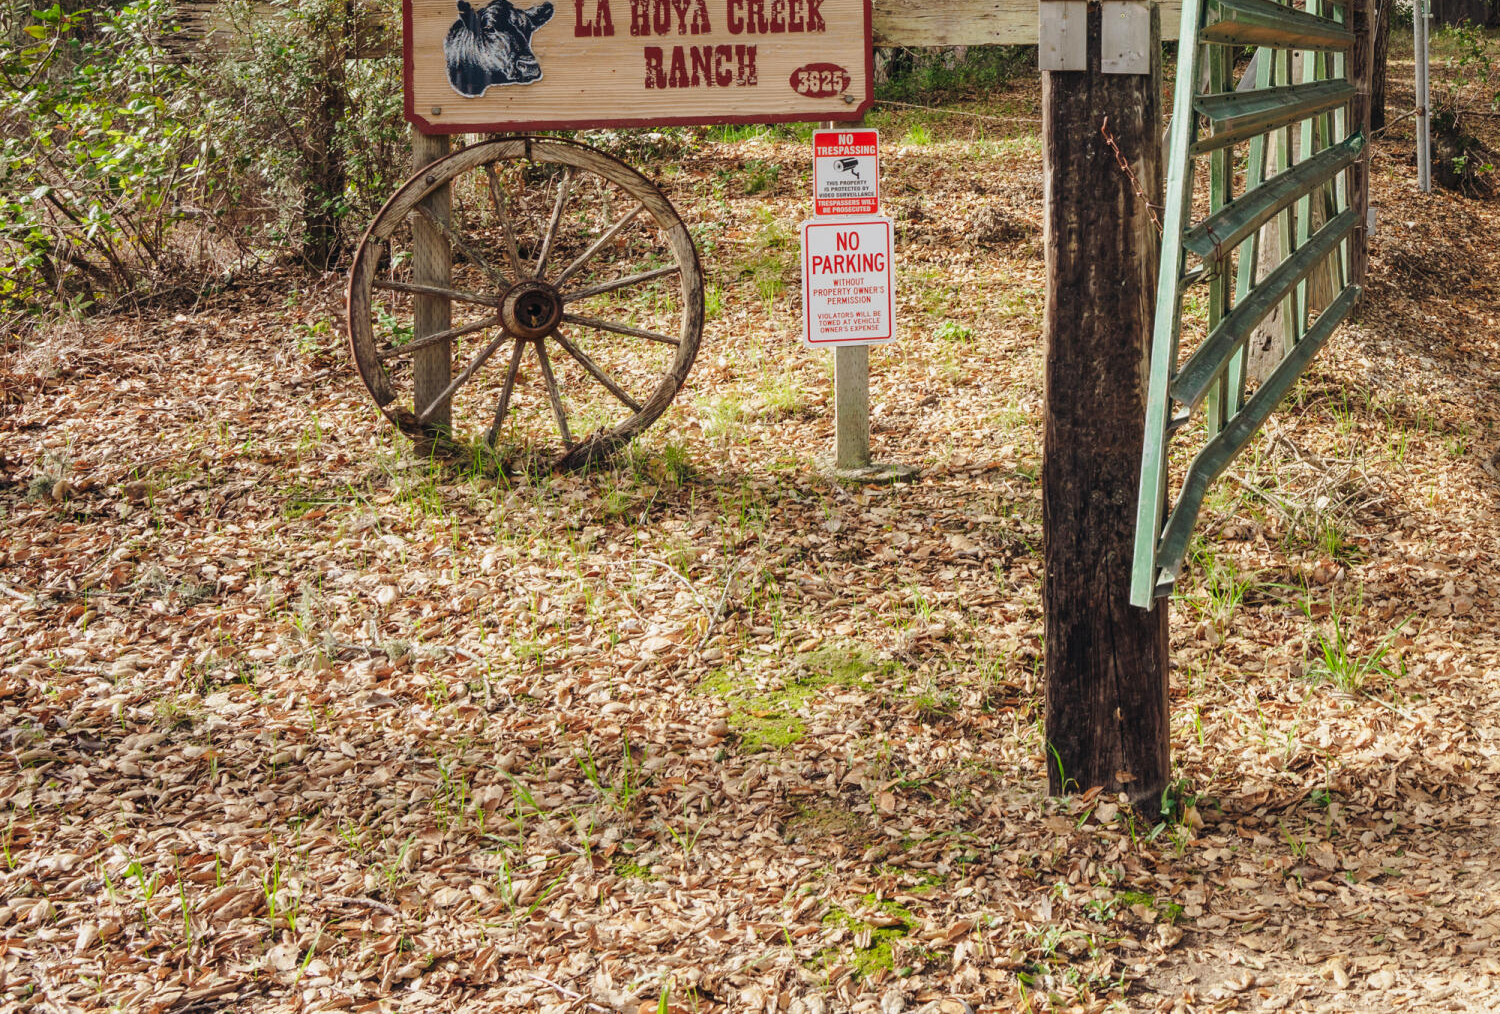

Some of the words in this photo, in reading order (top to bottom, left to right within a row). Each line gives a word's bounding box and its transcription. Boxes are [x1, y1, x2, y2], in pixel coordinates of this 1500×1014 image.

[643, 44, 759, 89] RANCH
[797, 70, 843, 93] 3825
[838, 134, 854, 145] NO
[816, 145, 876, 155] TRESPASSING
[818, 199, 860, 207] TRESPASSERS
[836, 231, 860, 252] NO
[812, 252, 885, 275] PARKING
[833, 277, 864, 286] WITHOUT
[812, 287, 851, 297] PROPERTY
[853, 285, 885, 295] OWNER'S
[827, 295, 872, 305] PERMISSION
[817, 311, 854, 319] VIOLATORS
[853, 317, 881, 325] VEHICLE
[850, 324, 880, 332] EXPENSE
